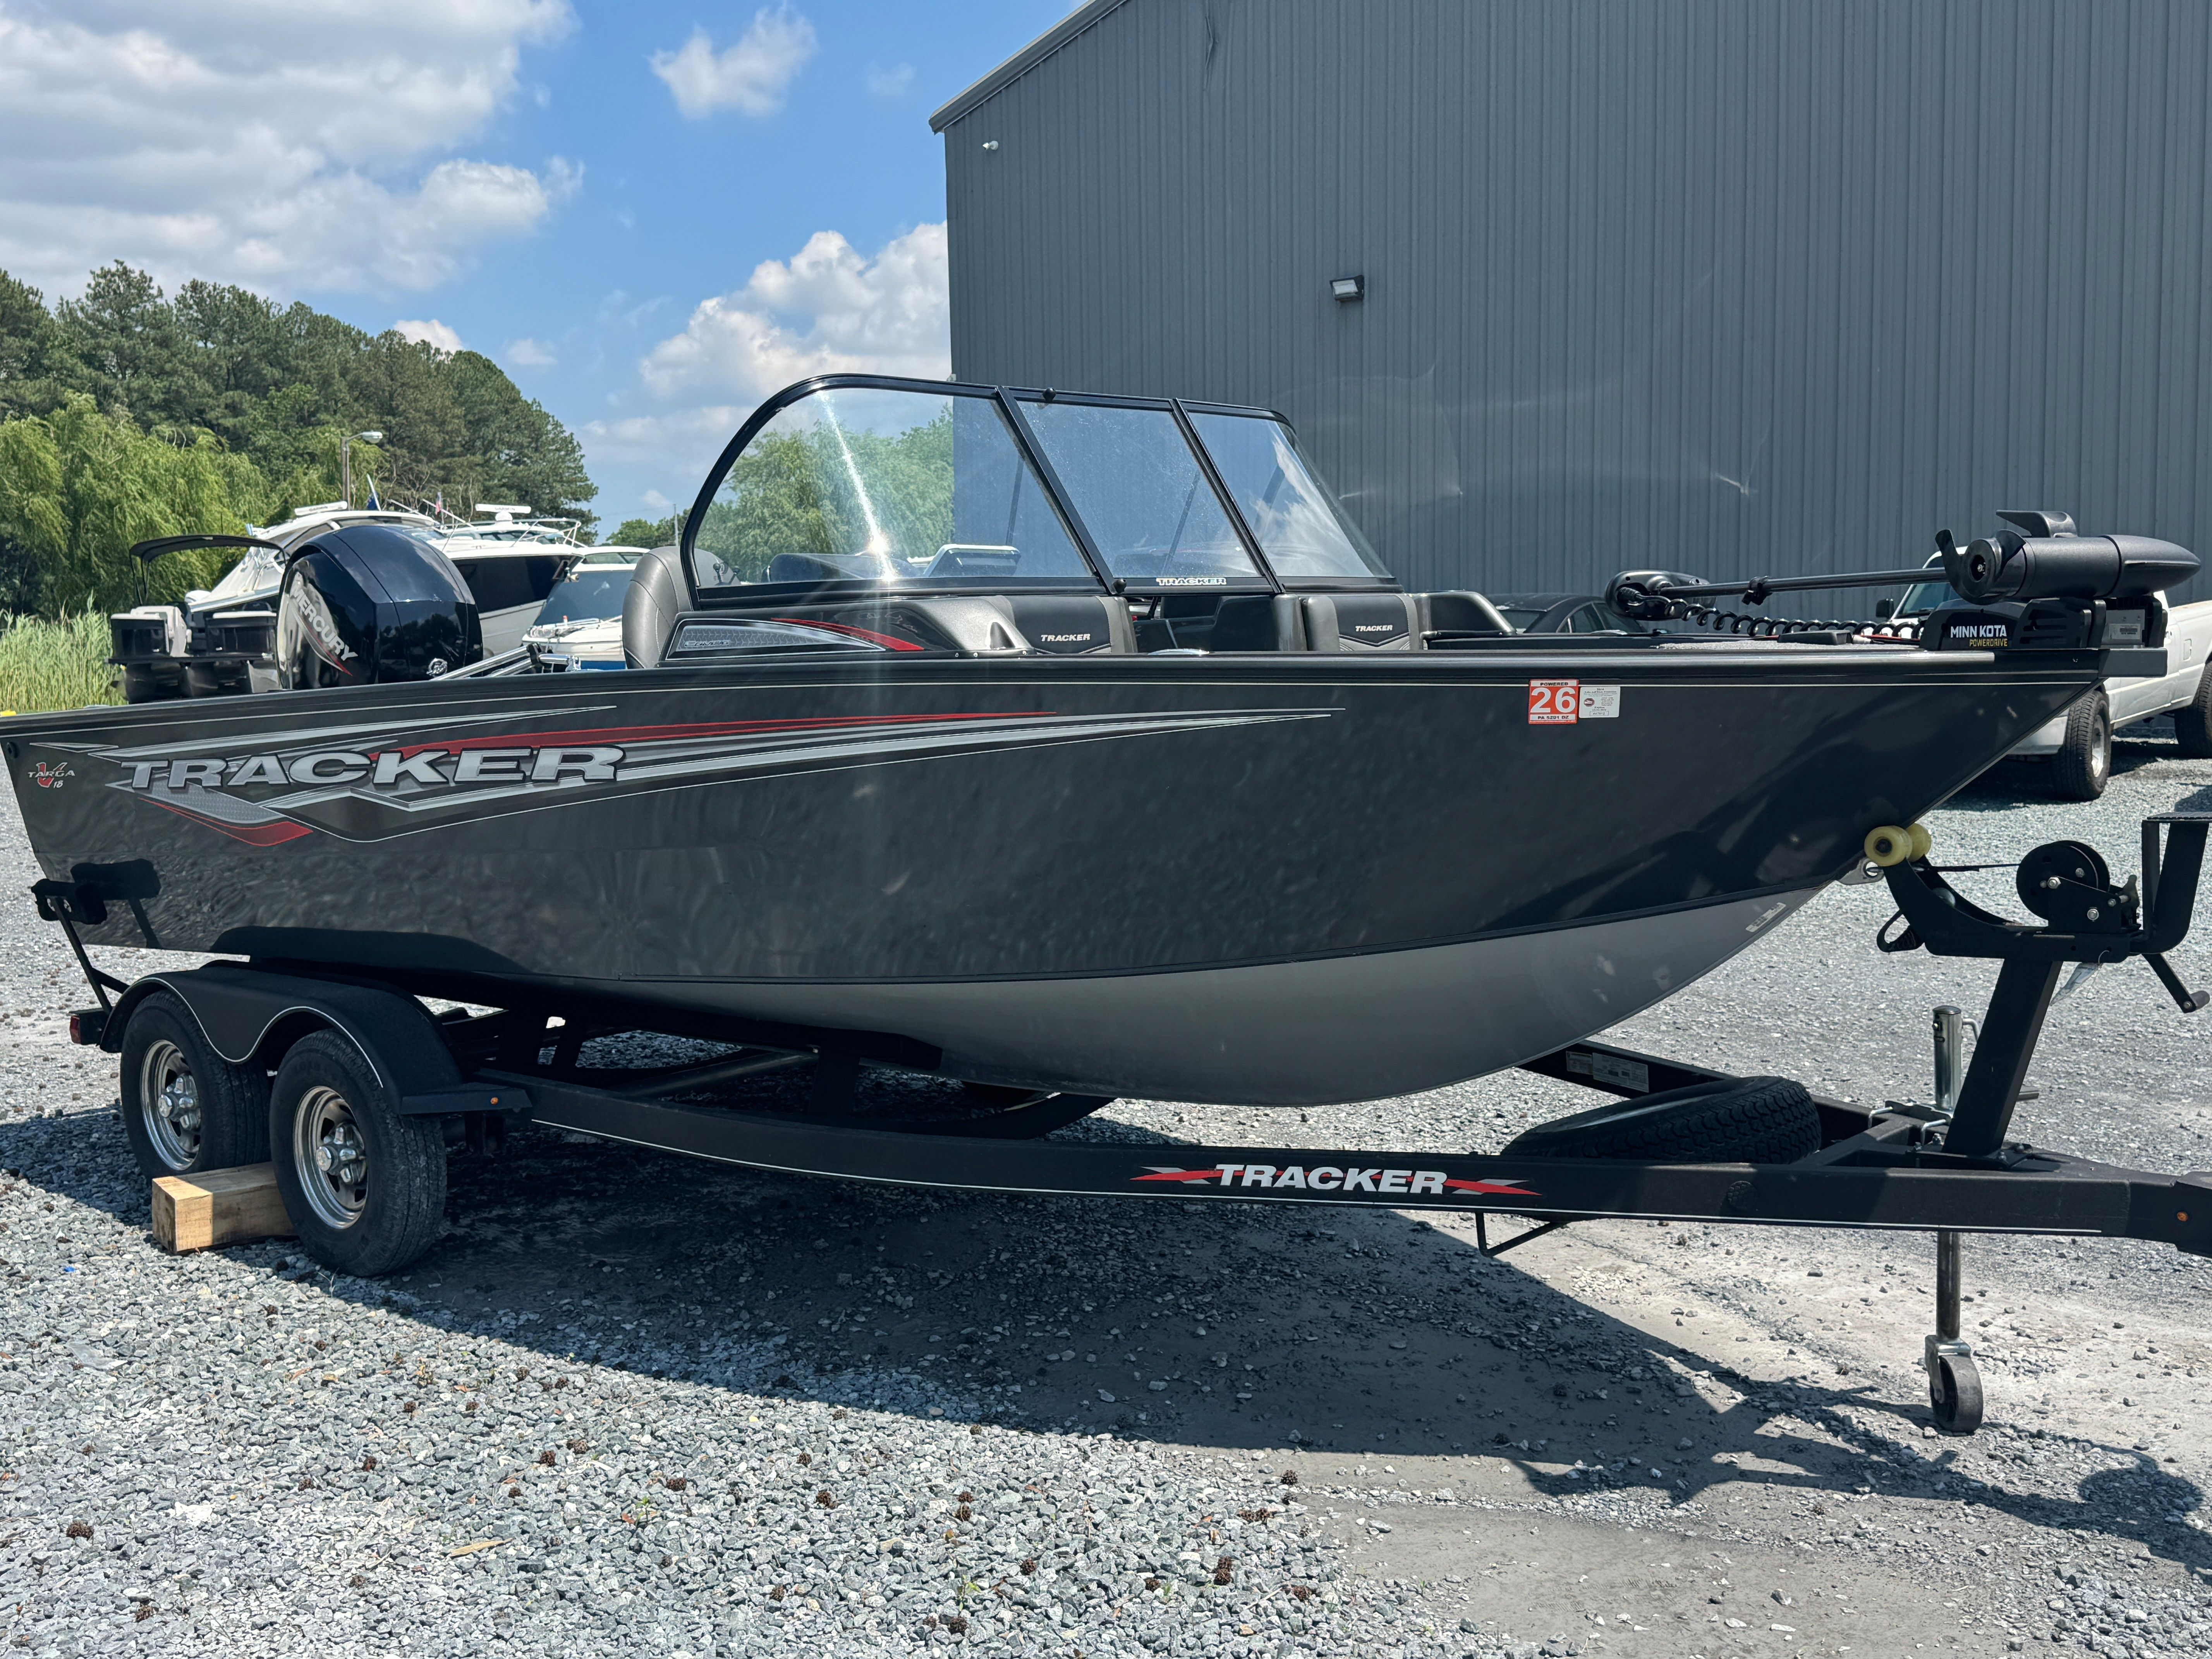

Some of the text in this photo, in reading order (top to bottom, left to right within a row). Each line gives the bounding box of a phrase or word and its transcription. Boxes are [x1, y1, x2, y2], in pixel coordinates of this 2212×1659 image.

[1156, 577, 1227, 586] TRACKER
[292, 588, 359, 661] MERCURY
[1950, 625, 2007, 638] MINN KOTA
[1041, 634, 1091, 642] TRACKER
[1969, 638, 2008, 647] POWERDRIVE
[1530, 687, 1576, 713] 26
[120, 745, 625, 789] TRACKER
[27, 770, 76, 778] TARGA
[53, 780, 64, 788] 18
[1215, 1163, 1448, 1195] TRACKER
